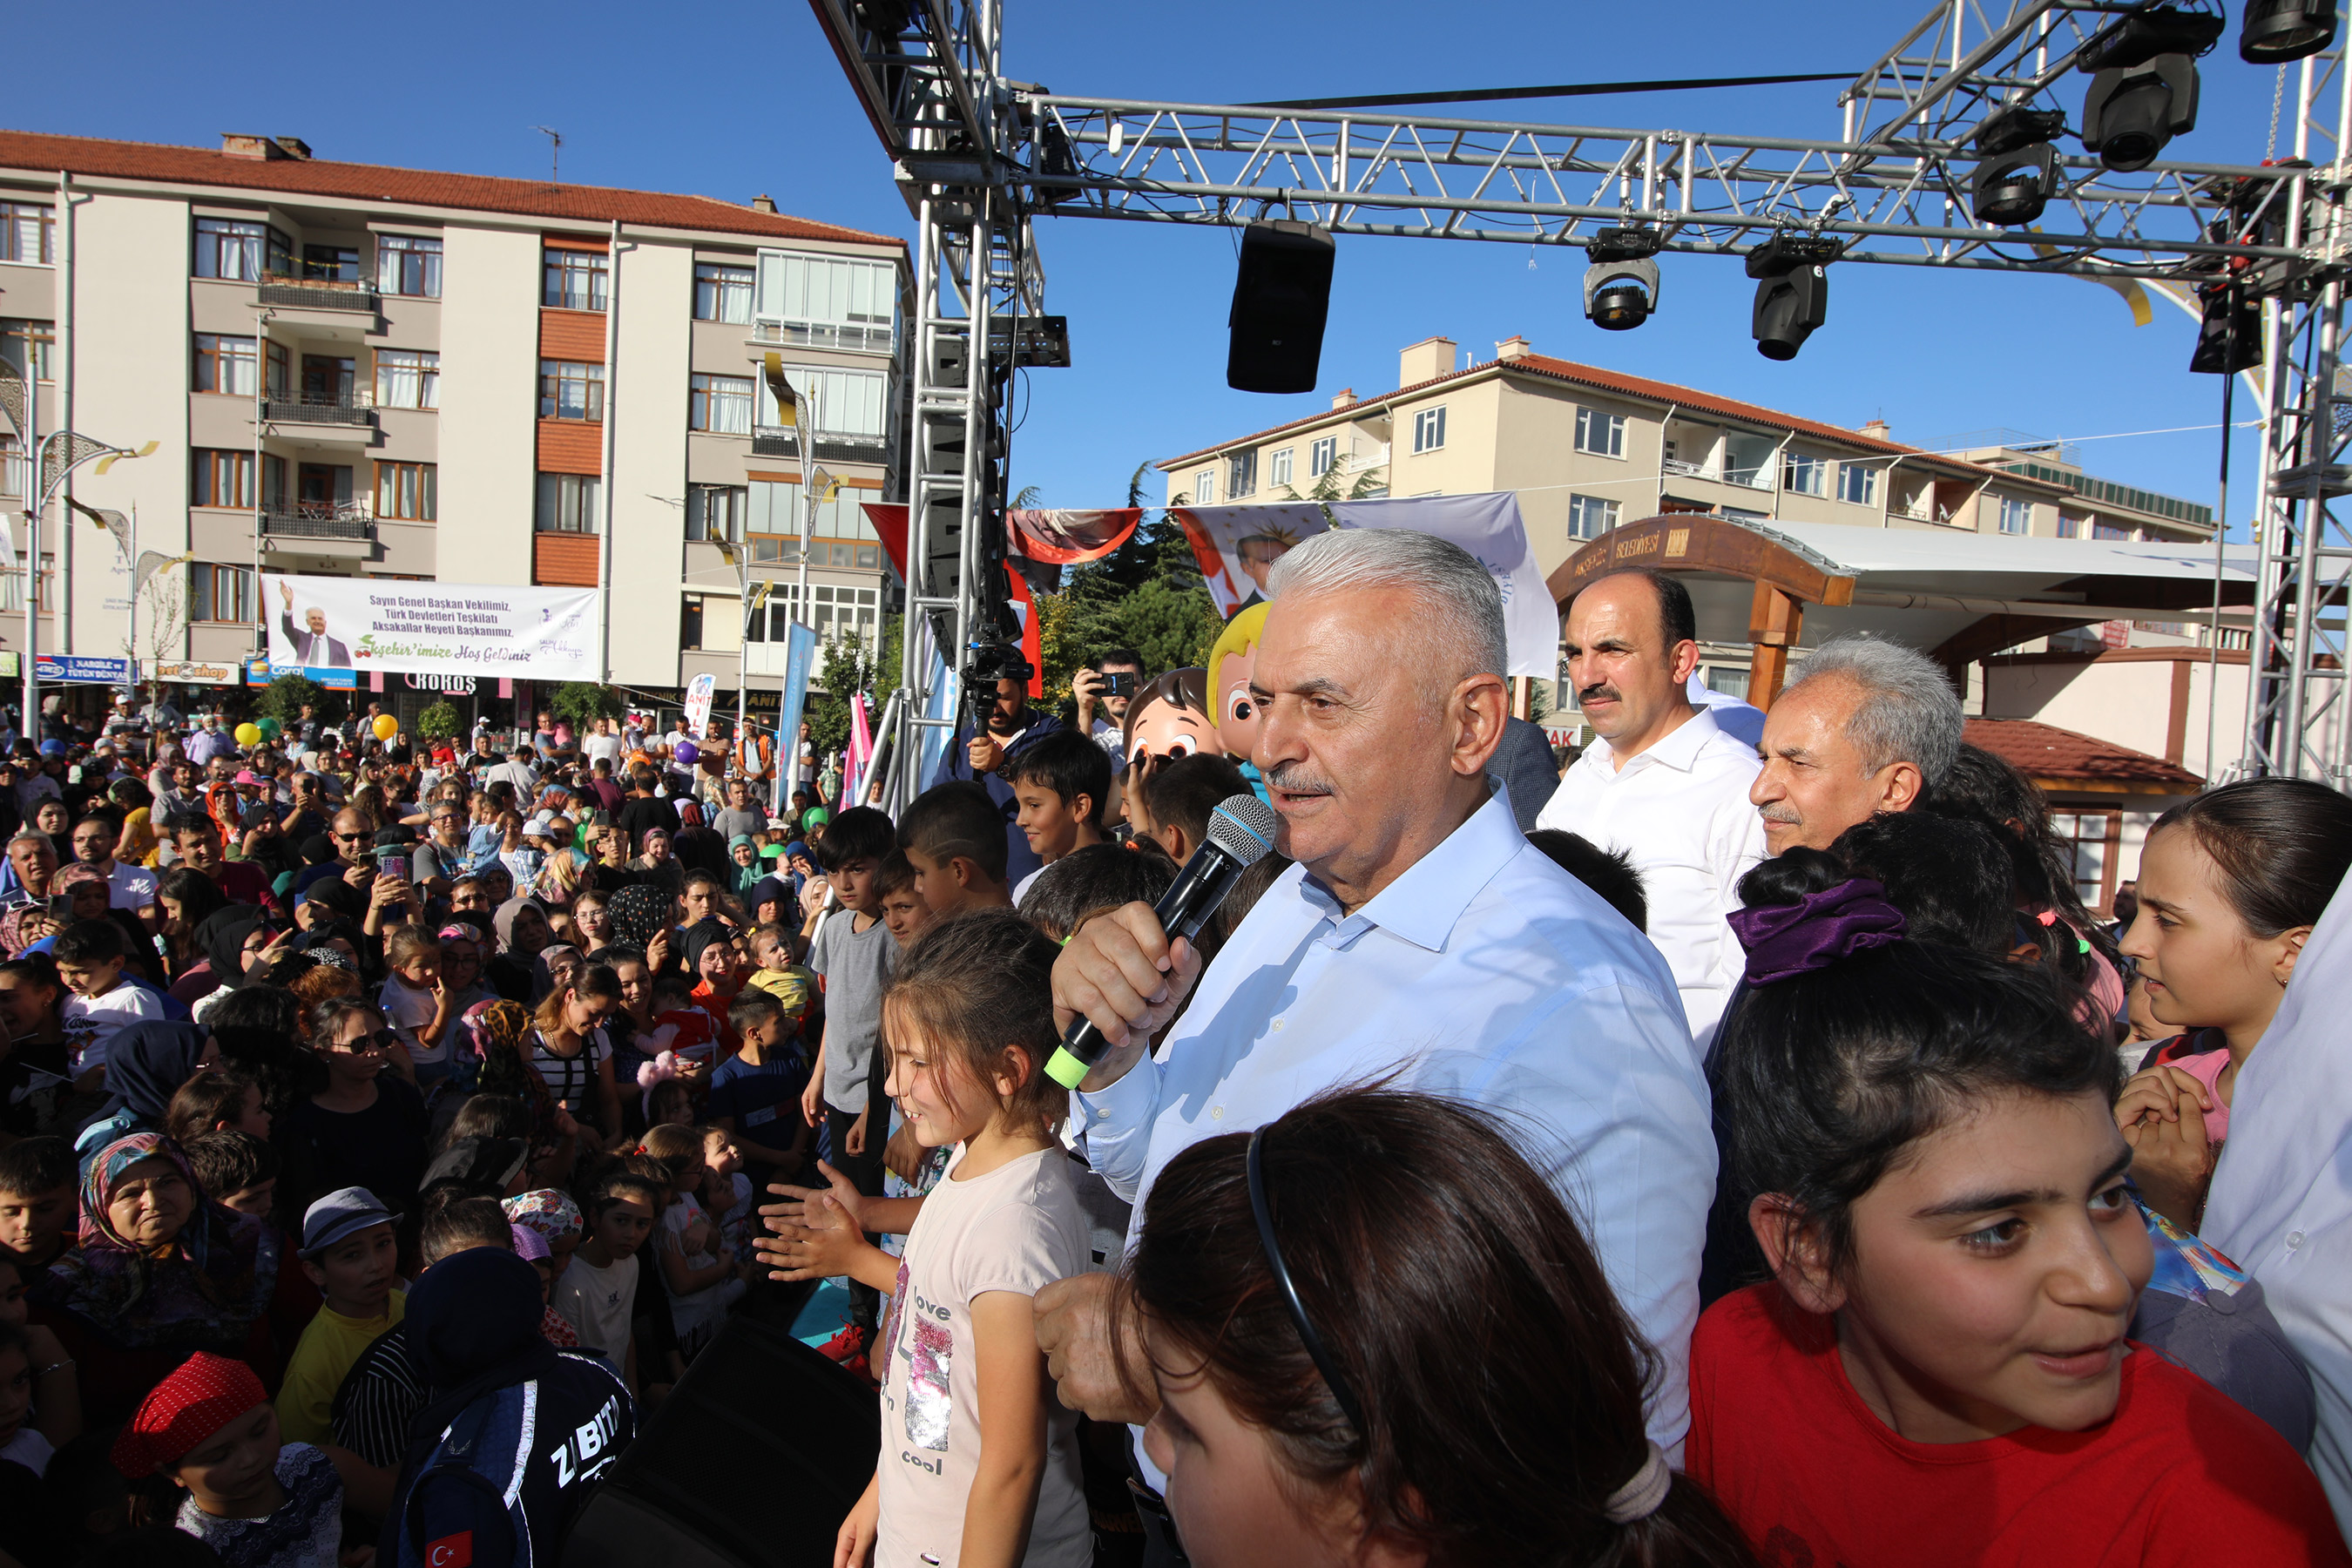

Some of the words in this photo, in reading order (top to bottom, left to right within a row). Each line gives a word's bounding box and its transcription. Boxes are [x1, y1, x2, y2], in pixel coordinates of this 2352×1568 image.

[2053, 152, 2061, 165] 5
[1814, 265, 1823, 278] 6
[1616, 530, 1660, 559] BELEDİYESİ
[369, 595, 396, 608] Sayın
[398, 597, 426, 608] Genel
[428, 598, 463, 610] Başkan
[464, 599, 511, 612] Vekilimiz,
[385, 608, 407, 619] Türk
[409, 611, 455, 622] Devletleri
[456, 612, 498, 624] Teşkilatı
[372, 621, 422, 633] Aksakallar
[424, 624, 455, 635] Heyeti
[456, 625, 514, 638] Başkanımız,
[454, 645, 481, 662] Hoş
[483, 647, 531, 663] Geldiniz
[95, 670, 128, 679] DÜNYAS
[157, 666, 179, 678] pet
[193, 665, 228, 680] shop
[271, 666, 305, 677] Coral
[416, 672, 476, 695] KOKOŞ
[638, 691, 678, 702] TEKNİK
[1205, 849, 1216, 861] BETA
[914, 1285, 951, 1321] love
[902, 1450, 943, 1477] cool
